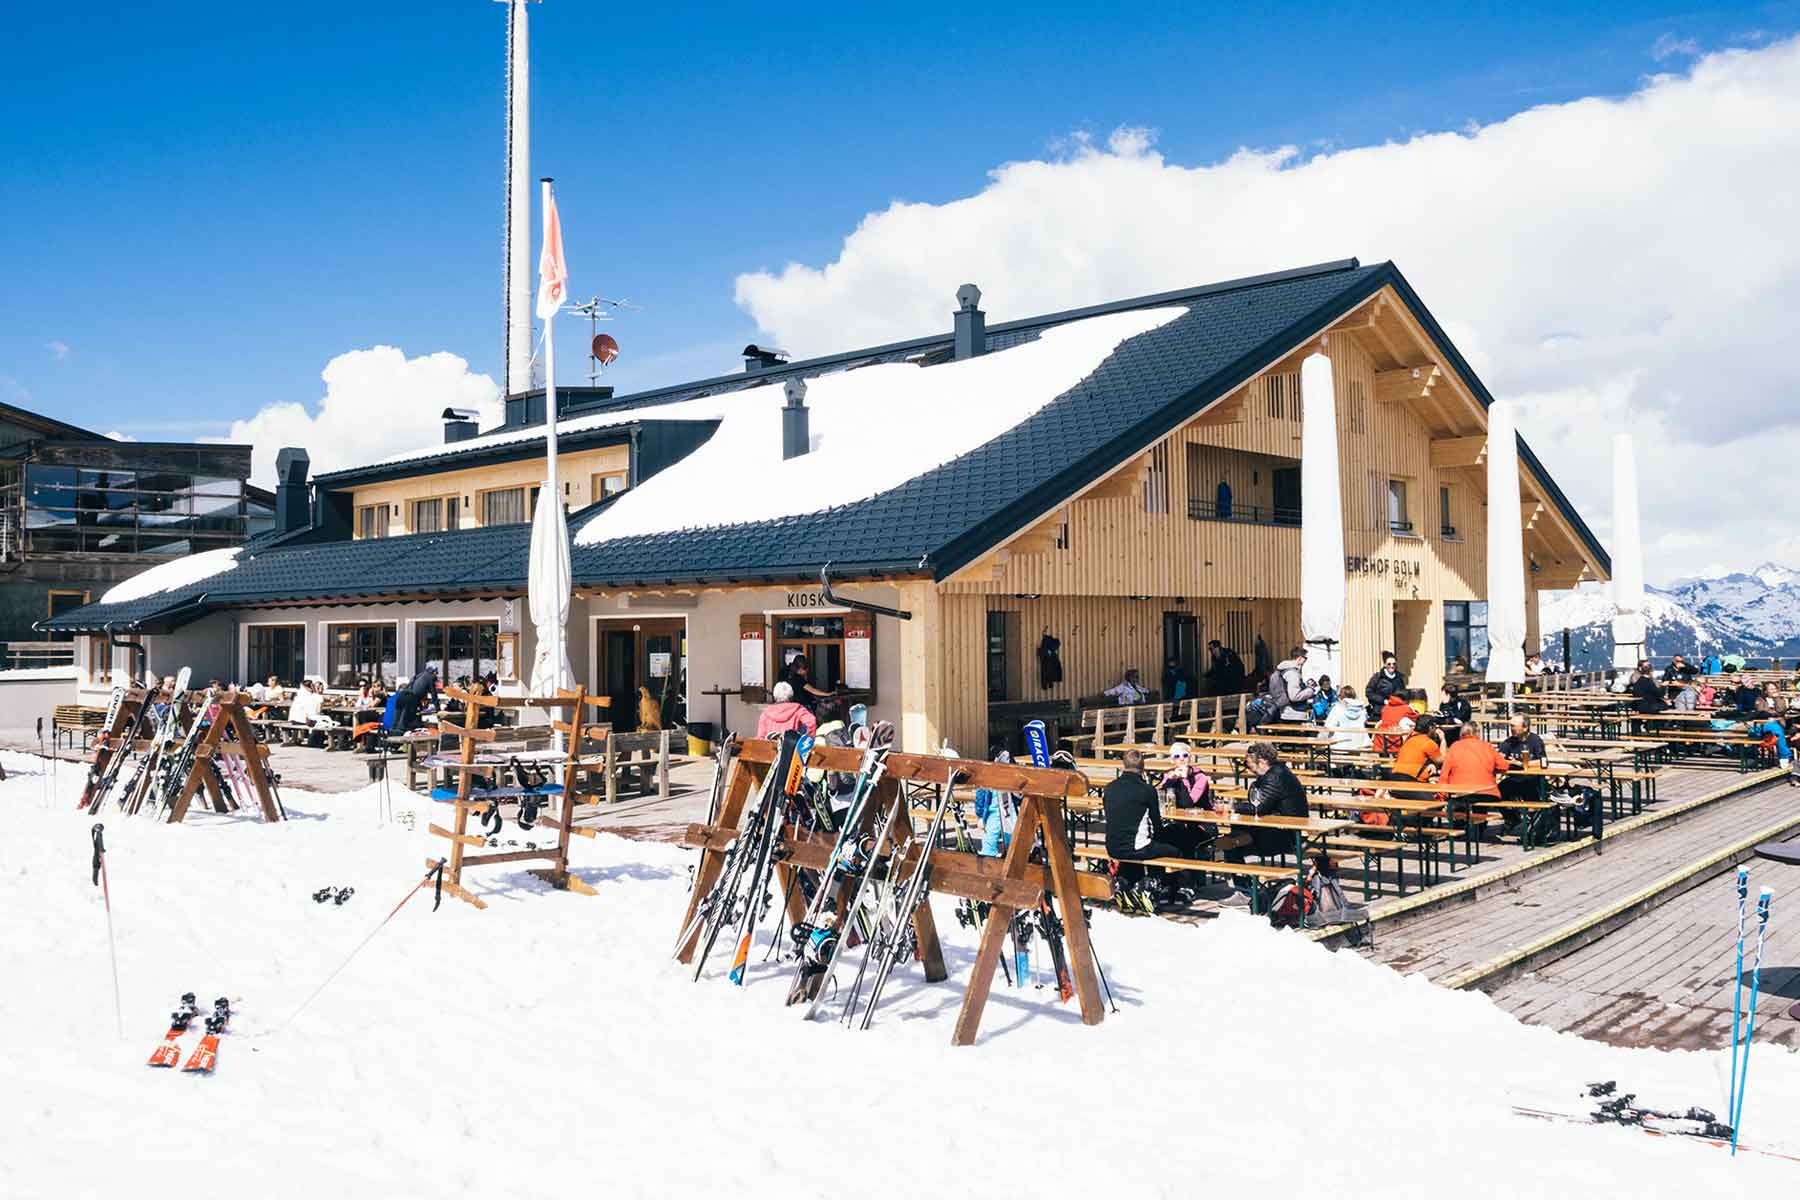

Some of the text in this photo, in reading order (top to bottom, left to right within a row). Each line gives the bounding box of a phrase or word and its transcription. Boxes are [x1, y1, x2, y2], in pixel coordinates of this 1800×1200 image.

[1345, 556, 1420, 576] ERGHOF GOLM
[787, 593, 825, 607] KIOSK
